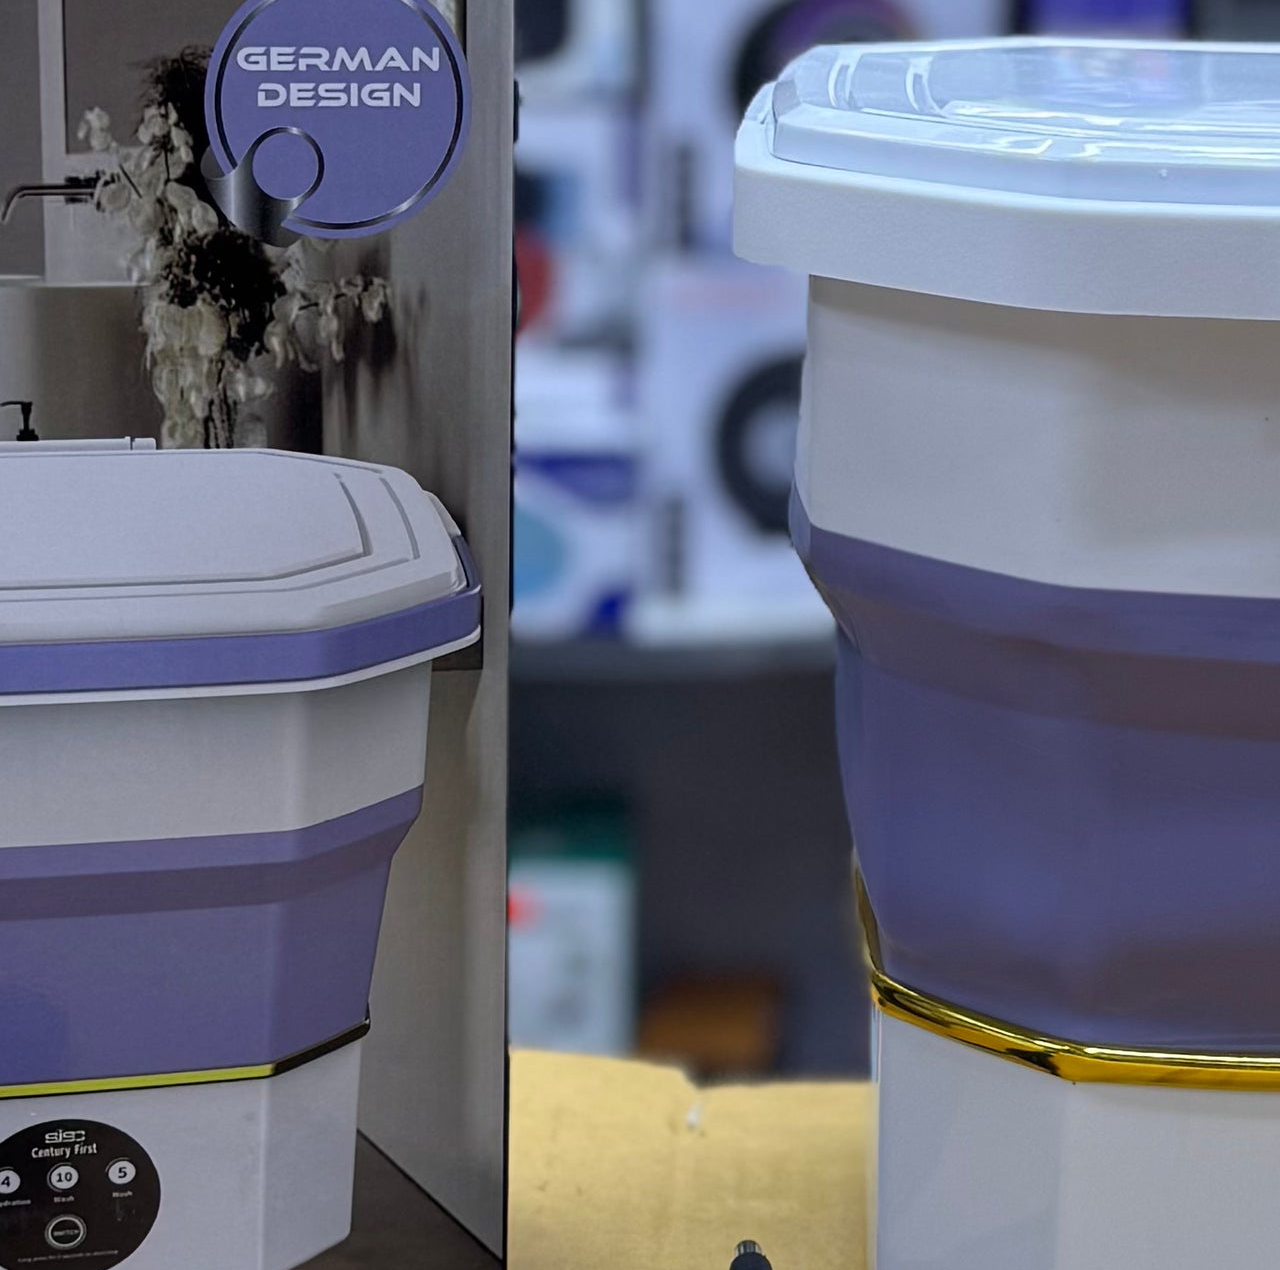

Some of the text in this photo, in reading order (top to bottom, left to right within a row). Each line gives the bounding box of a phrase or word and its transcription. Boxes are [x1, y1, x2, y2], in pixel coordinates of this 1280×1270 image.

[236, 45, 440, 72] GERMAN
[257, 82, 422, 108] DESIGN
[31, 1142, 98, 1158] Century First
[56, 1171, 73, 1183] 10
[117, 1166, 128, 1179] 5
[1, 1175, 11, 1187] 4
